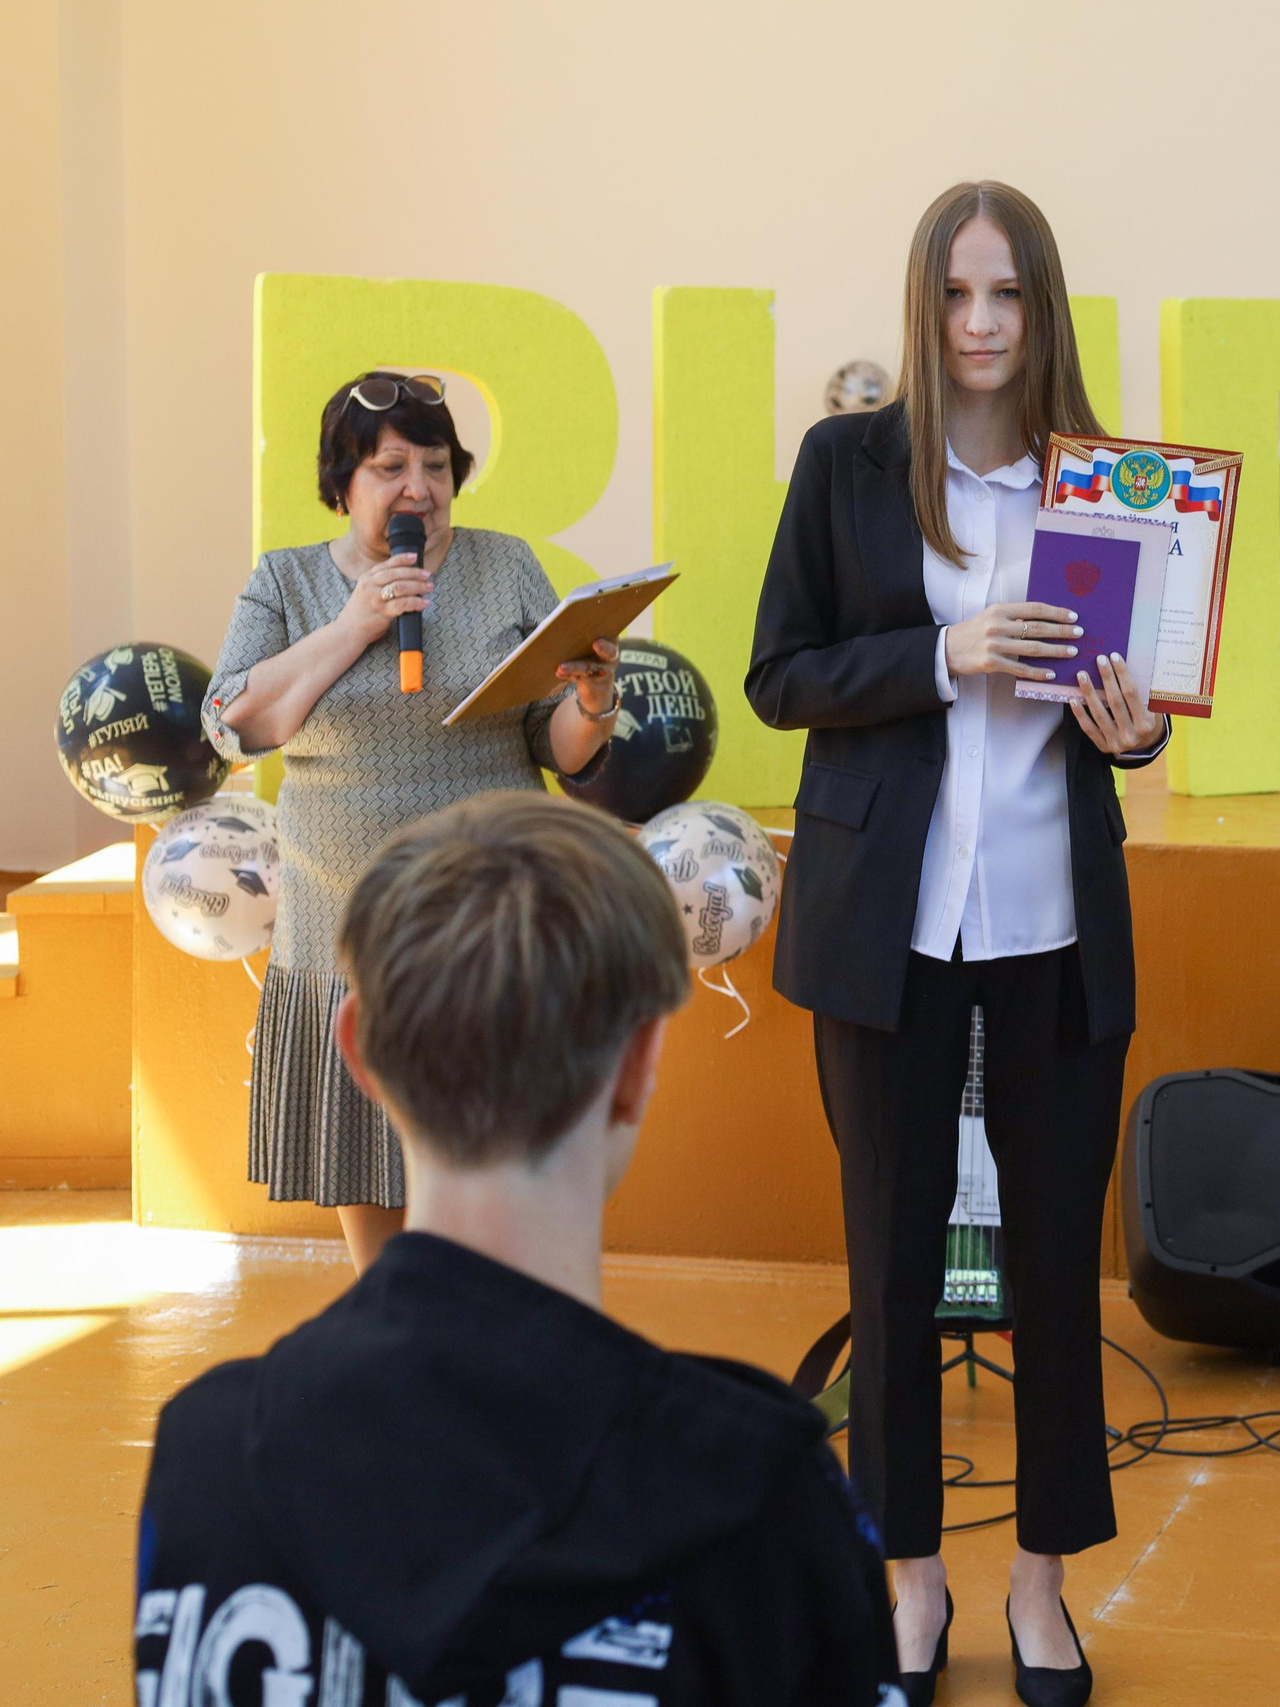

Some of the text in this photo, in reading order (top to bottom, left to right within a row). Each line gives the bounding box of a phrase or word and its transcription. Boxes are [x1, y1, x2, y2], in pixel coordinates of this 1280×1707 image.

[141, 651, 169, 713] #ТЕПЕРЬ
[158, 647, 183, 703] МОЖНО
[647, 694, 706, 724] ДЕНЬ
[88, 713, 149, 749] #ГУЛЯЙ
[81, 754, 125, 781] #ДА!
